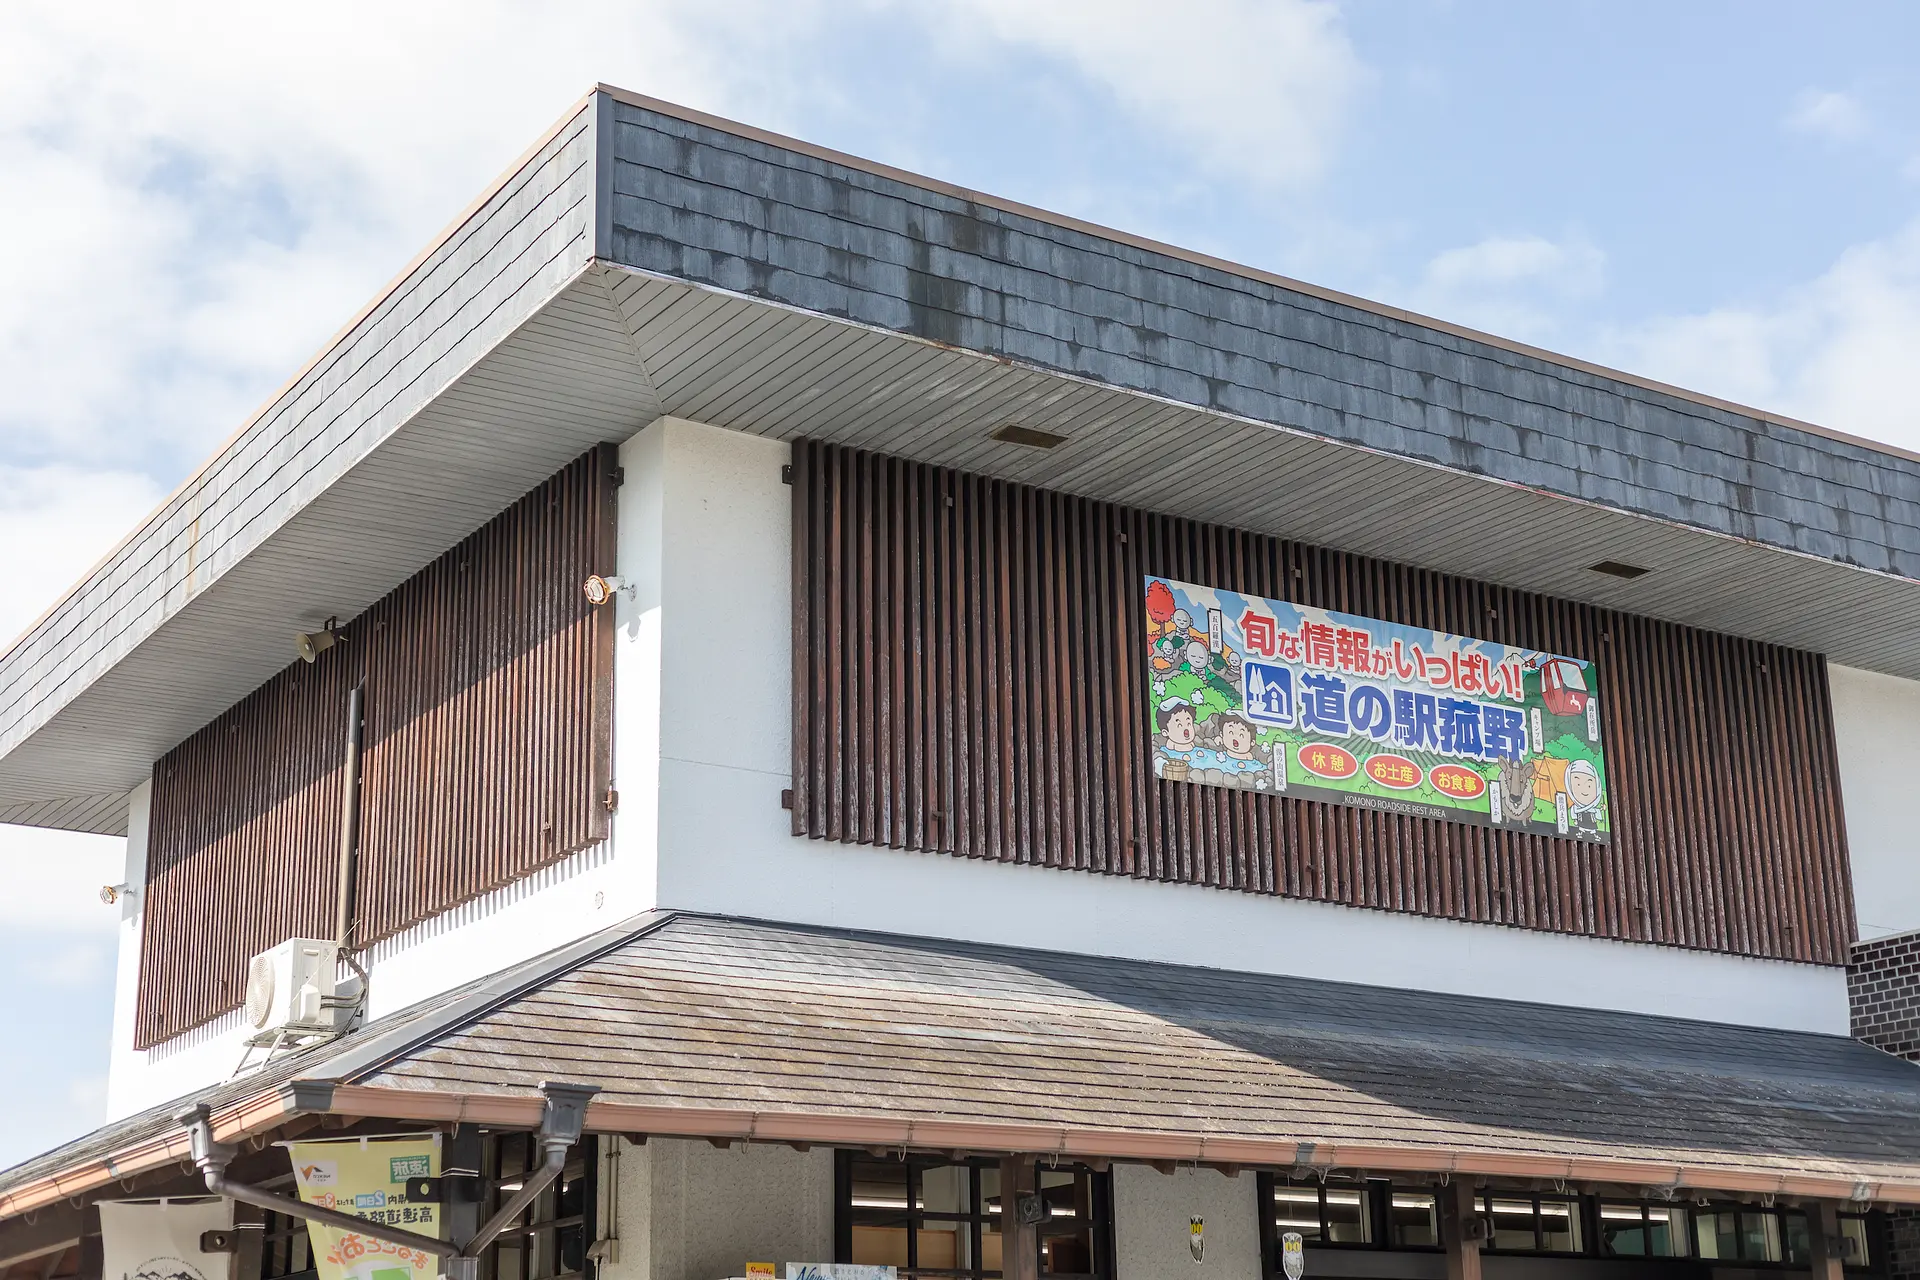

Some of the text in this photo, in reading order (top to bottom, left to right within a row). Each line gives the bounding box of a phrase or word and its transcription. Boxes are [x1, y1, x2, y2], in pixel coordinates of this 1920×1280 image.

[1300, 671, 1526, 764] 道の駅菰野
[1311, 750, 1478, 793] 休憩 お土産 お食事
[1344, 794, 1447, 818] KOMONO ROADSIDE REST AREA
